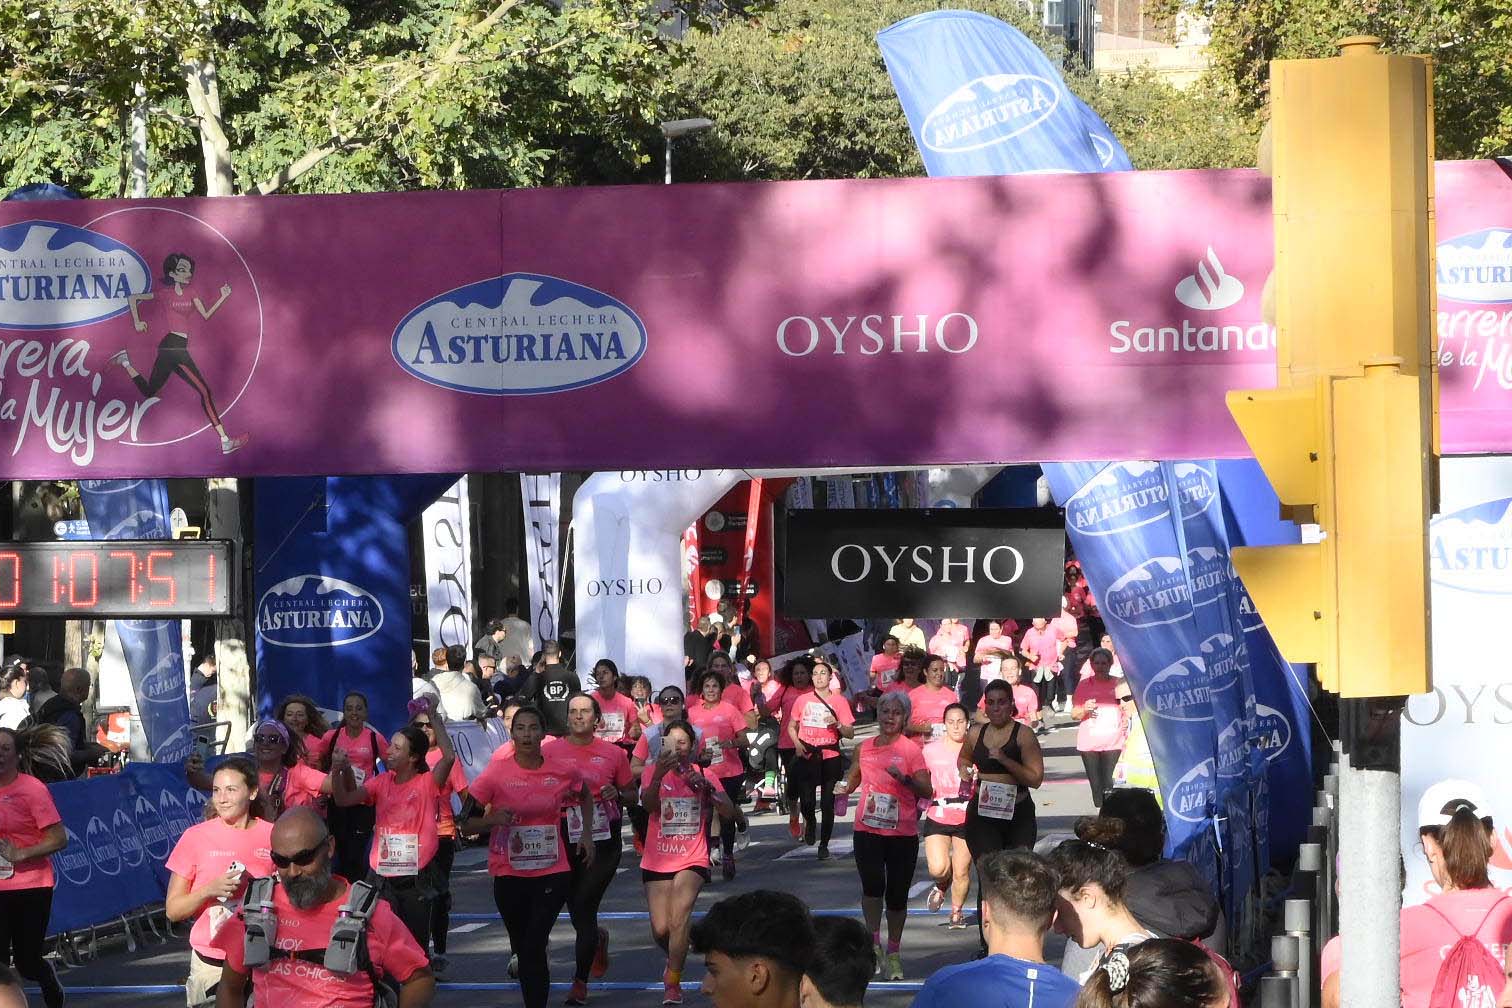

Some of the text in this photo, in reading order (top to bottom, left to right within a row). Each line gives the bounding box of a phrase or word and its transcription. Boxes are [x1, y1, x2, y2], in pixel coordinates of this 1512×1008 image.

[54, 255, 127, 268] LECHERA
[451, 313, 618, 329] CENTRAL LECHERA
[412, 320, 627, 366] ASTURIANA
[776, 312, 979, 357] OYSHO
[11, 373, 161, 467] Mujer
[831, 544, 1025, 584] OYSHO
[587, 577, 663, 598] OYSHO
[261, 608, 374, 633] ASTURIANA
[549, 685, 564, 696] BP
